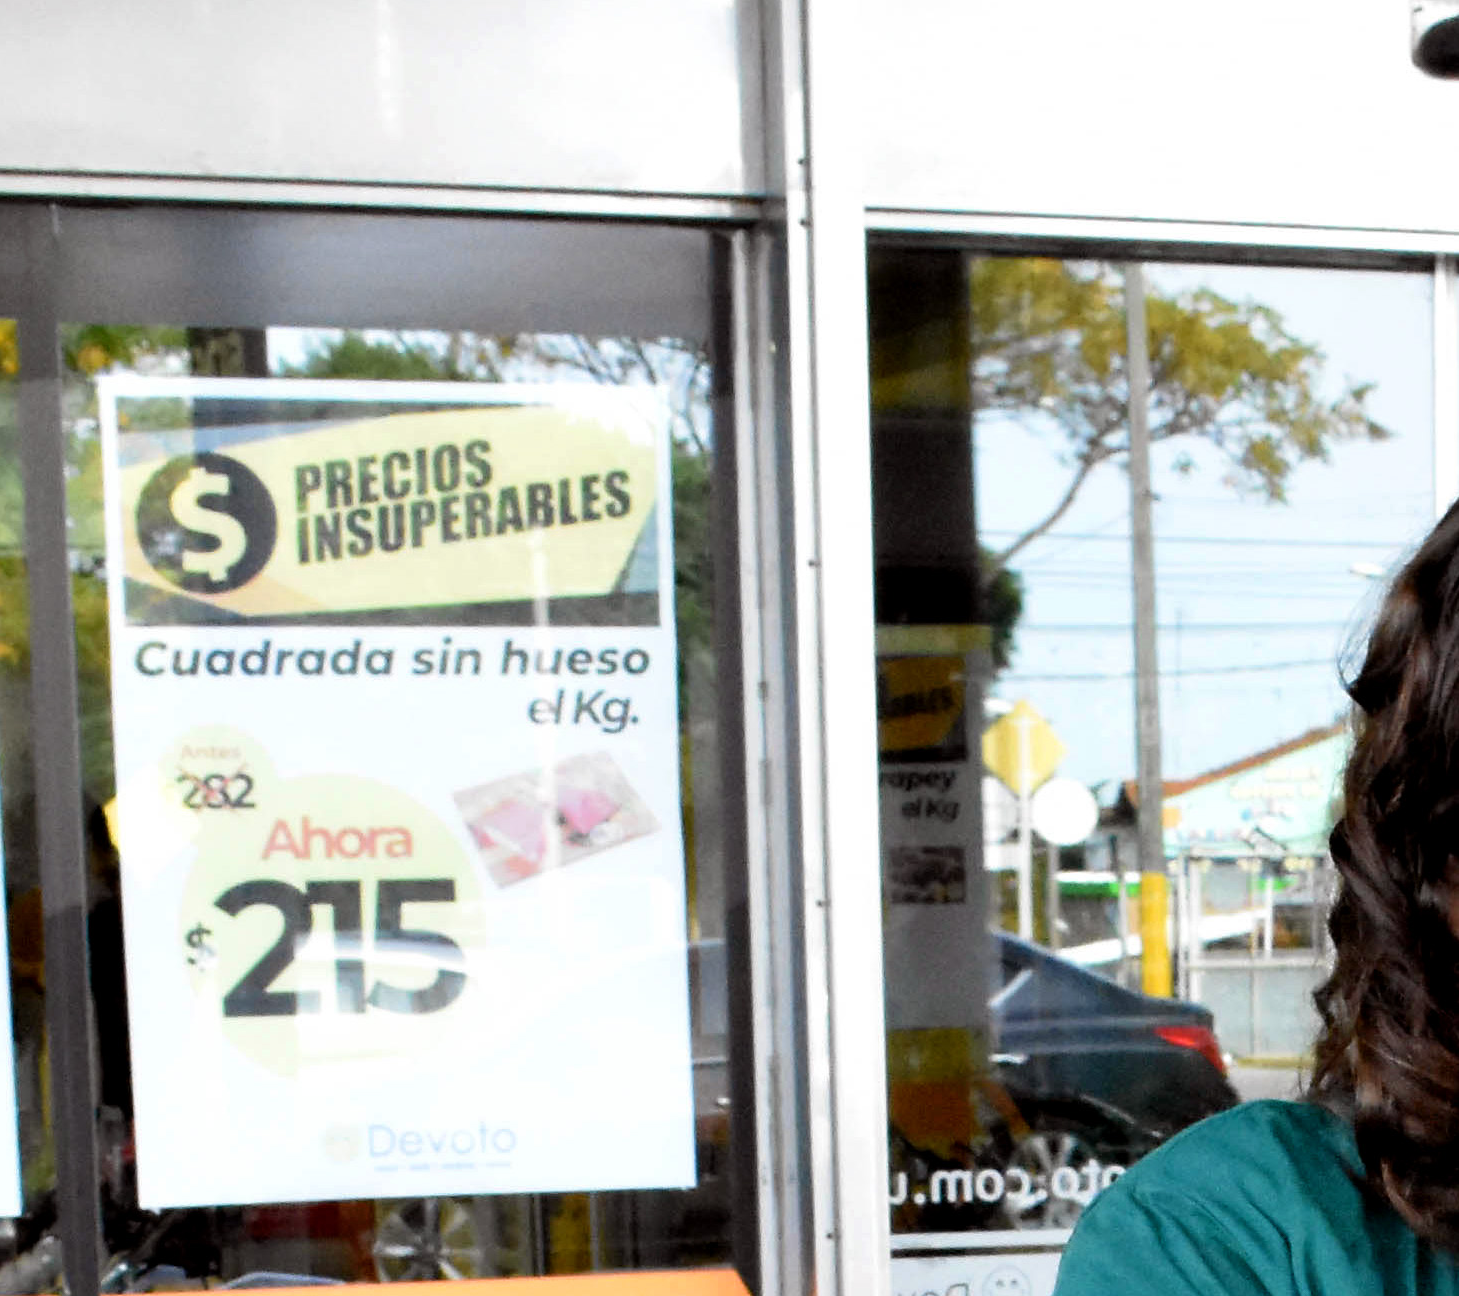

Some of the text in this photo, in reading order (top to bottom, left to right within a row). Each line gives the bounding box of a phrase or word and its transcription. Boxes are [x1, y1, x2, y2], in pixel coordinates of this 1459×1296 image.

[294, 440, 492, 513] PRECIOS
[296, 470, 632, 566] INSUPERABLES
[134, 636, 652, 677] Cuadrada sin hueso
[572, 688, 642, 735] Kg.
[260, 814, 415, 862] Ahora
[367, 1121, 518, 1160] Devoto
